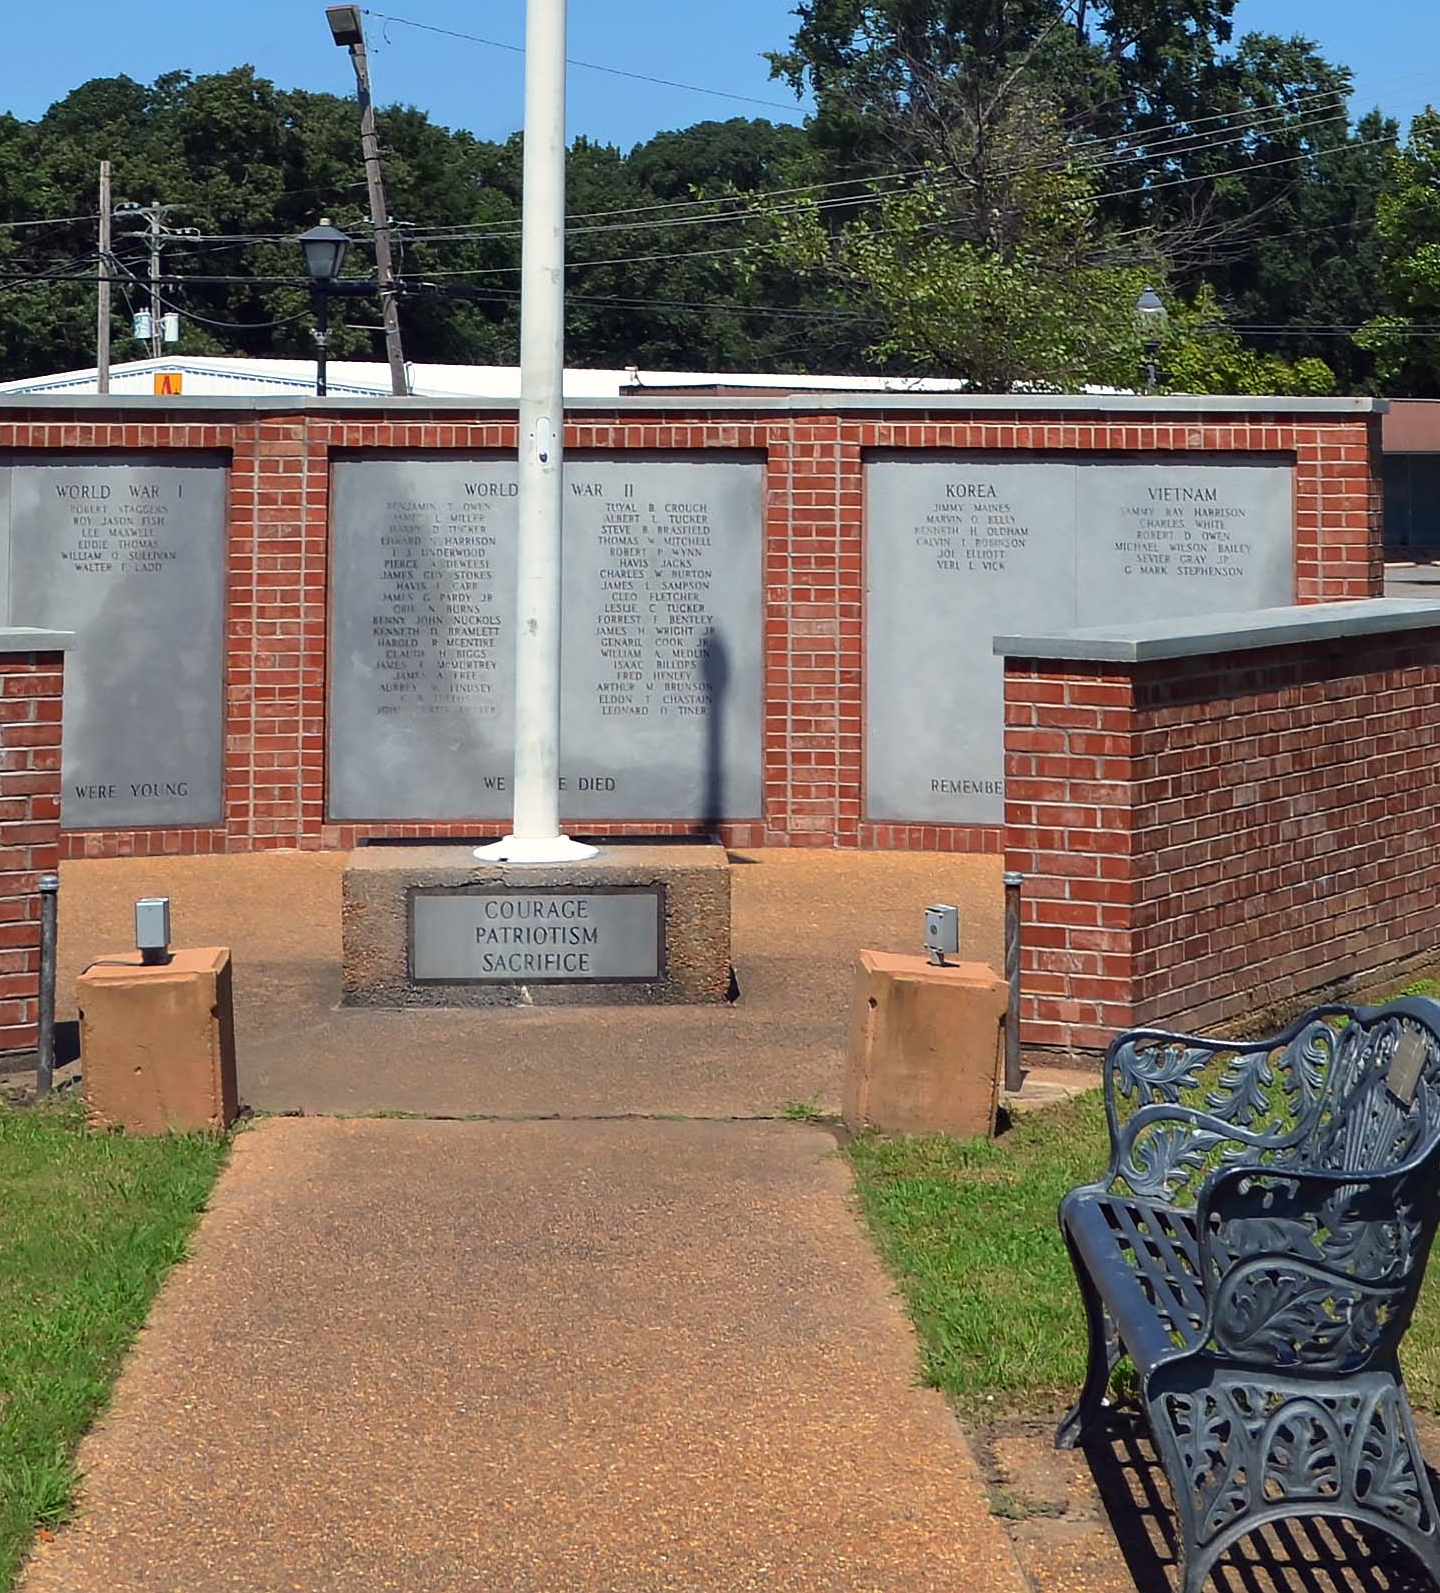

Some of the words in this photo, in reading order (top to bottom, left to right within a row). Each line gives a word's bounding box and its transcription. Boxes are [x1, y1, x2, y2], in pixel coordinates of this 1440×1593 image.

[56, 485, 110, 499] WORLD
[129, 485, 159, 499] WAR
[178, 485, 182, 499] I
[465, 483, 519, 496] WORLD
[571, 484, 603, 497] WAR
[624, 484, 633, 497] II
[946, 484, 996, 497] KOREA
[1148, 488, 1217, 501] VIETNAM
[665, 503, 707, 512] CROUCH
[1166, 508, 1183, 516] RAY
[1195, 508, 1245, 516] HARRISON
[73, 517, 91, 525] ROY
[102, 517, 133, 525] JASON
[142, 517, 165, 525] FISH
[604, 515, 639, 523] ALBERT
[669, 515, 707, 523] TUCKER
[927, 516, 962, 524] MARVIN
[1140, 519, 1185, 528] CHARLES
[1195, 520, 1225, 529] WHITE
[602, 526, 631, 535] STEVE
[658, 526, 710, 535] BRASFIELD
[987, 527, 1028, 535] OLDHAM
[1202, 532, 1230, 540] OWEN
[79, 540, 109, 549] EDDIE
[119, 540, 159, 549] THOMAS
[445, 537, 496, 545] HARRISON
[599, 537, 639, 545] THOMAS
[664, 537, 712, 545] MITCHELL
[1114, 543, 1158, 551] MICHAEL
[1169, 543, 1207, 552] WILSON
[1219, 544, 1251, 553] BAILEY
[62, 552, 101, 560] WILLIAM
[129, 552, 176, 560] SULLIVAN
[422, 549, 485, 557] UNDERWOOD
[610, 548, 646, 557] ROBERT
[673, 548, 702, 557] WYNN
[967, 550, 1005, 559] ELLIOTT
[1180, 555, 1206, 563] GRAY
[75, 563, 112, 572] WALTER
[135, 563, 161, 572] LADD
[385, 560, 418, 568] PIERCE
[620, 559, 648, 568] HAVIS
[661, 559, 692, 568] JACKS
[937, 561, 960, 570] VERL
[982, 561, 1005, 570] VICK
[381, 571, 413, 579] JAMES
[454, 571, 492, 579] STOKES
[600, 570, 644, 578] CHARLES
[672, 570, 712, 578] BURTON
[1141, 567, 1168, 575] MARK
[1177, 567, 1243, 575] STEPHENSON
[602, 582, 633, 590] JAMES
[662, 582, 709, 590] SAMPSON
[612, 593, 637, 601] CLEO
[650, 593, 699, 601] FLETCHER
[447, 605, 480, 613] BURNS
[605, 604, 638, 613] LESLIE
[667, 604, 705, 613] TUCKER
[373, 616, 405, 625] BENNY
[416, 616, 443, 625] JOHN
[454, 616, 501, 625] NUCKOLS
[598, 616, 641, 624] FORREST
[670, 616, 713, 624] BENTLEY
[373, 628, 419, 636] KENNETH
[449, 628, 500, 636] BRAMLETT
[595, 627, 627, 635] JAMES
[656, 627, 694, 635] WRIGHT
[378, 639, 418, 647] HAROLD
[655, 638, 683, 647] COOK
[457, 650, 487, 658] BIGGS
[601, 650, 641, 658] WILLIAM
[673, 650, 710, 658] MEDLIN
[614, 661, 643, 669] ISAAC
[657, 661, 696, 669] BILLOPS
[617, 672, 642, 680] FRED
[654, 672, 691, 680] HENLEY
[597, 683, 635, 691] ARTHUR
[665, 683, 713, 691] BRUNSON
[599, 695, 632, 704] ELDON
[663, 695, 712, 704] CHASTAIN
[603, 707, 648, 715] LEONARD
[679, 707, 706, 715] TINER
[484, 777, 505, 790] WE
[579, 777, 615, 791] DIED
[931, 779, 1002, 794] REMEMBE
[75, 785, 117, 799] WERE
[131, 783, 187, 797] YOUNG
[485, 900, 588, 919] COURAGE
[476, 927, 598, 944] PATRIOTISM
[482, 954, 589, 972] SACRIFICE
